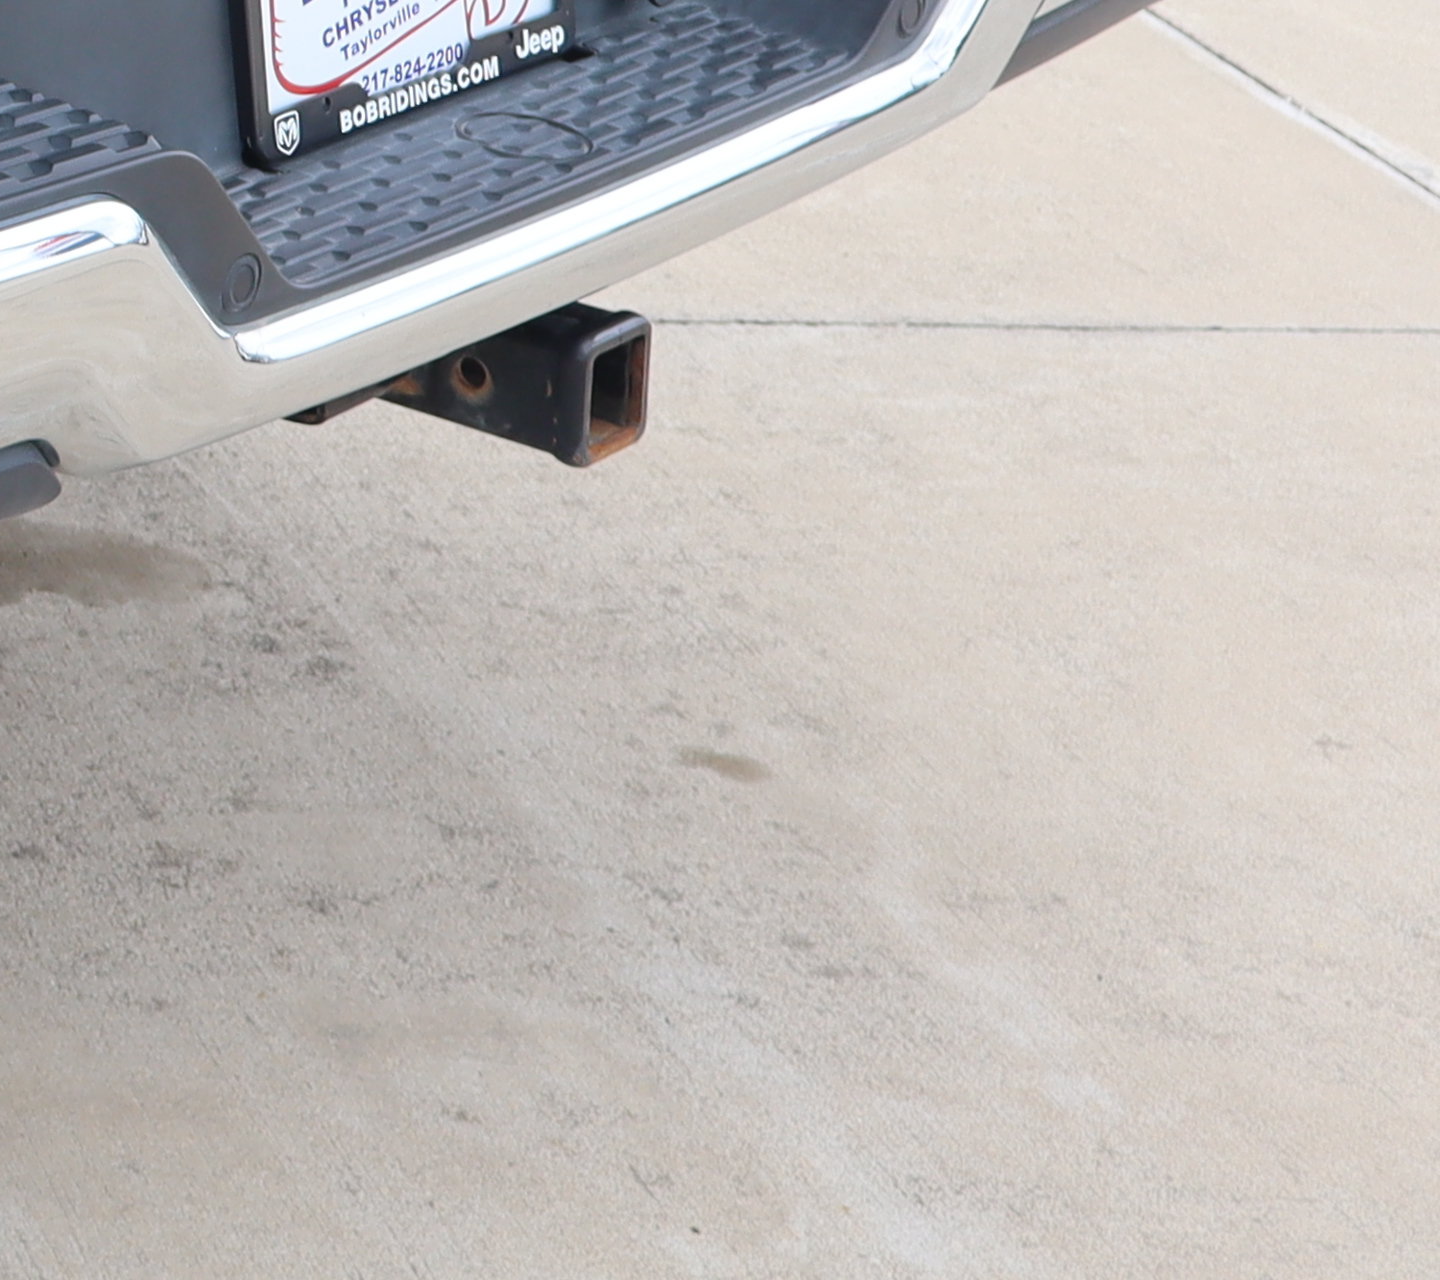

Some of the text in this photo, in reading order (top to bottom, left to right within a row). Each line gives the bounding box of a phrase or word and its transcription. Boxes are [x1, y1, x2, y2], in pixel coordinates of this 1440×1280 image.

[340, 2, 421, 61] Taylorville
[515, 24, 565, 59] Jeep
[339, 56, 499, 133] BOBRIDINGS.COM
[362, 42, 464, 95] 217-824-2200
